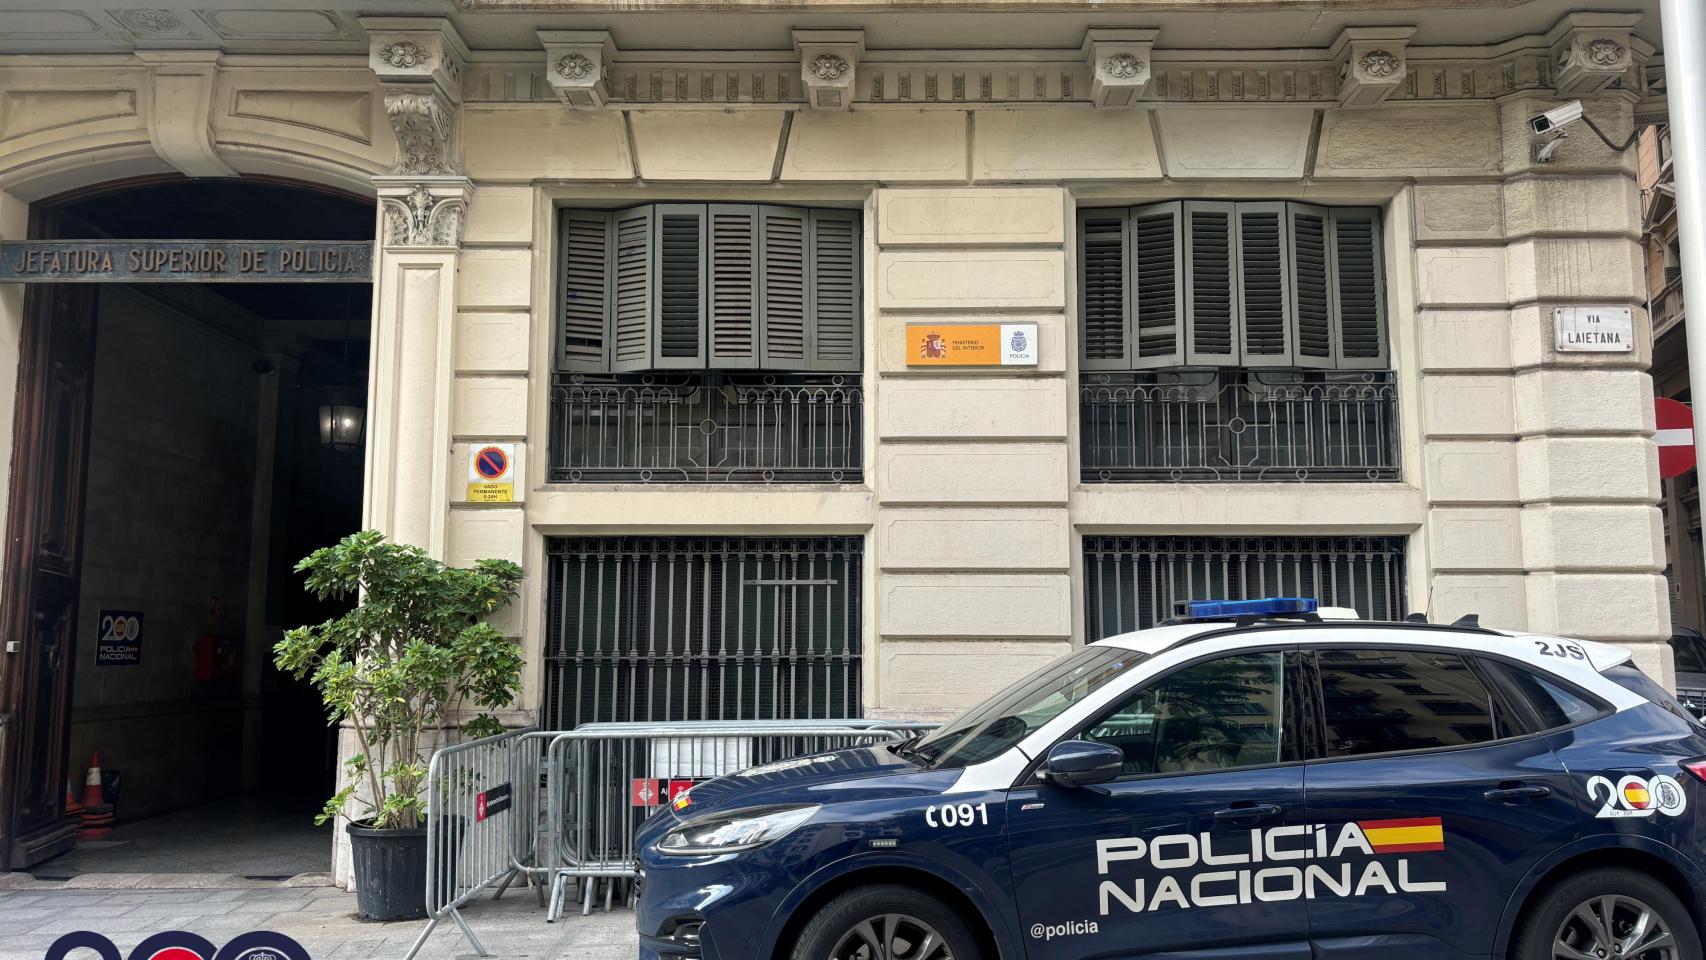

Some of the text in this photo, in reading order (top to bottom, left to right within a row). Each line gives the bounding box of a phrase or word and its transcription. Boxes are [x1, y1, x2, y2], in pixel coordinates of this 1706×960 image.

[14, 248, 357, 273] JEFATURA SUPERIOR DE POLICIA
[1587, 315, 1601, 324] VIA
[1568, 332, 1621, 344] LAIETANA
[102, 615, 140, 641] 200
[1534, 641, 1585, 660] 2JS
[1586, 774, 1687, 818] 200
[941, 802, 989, 827] 091
[1099, 858, 1447, 916] NACIONAL
[1030, 919, 1099, 941] @policia
